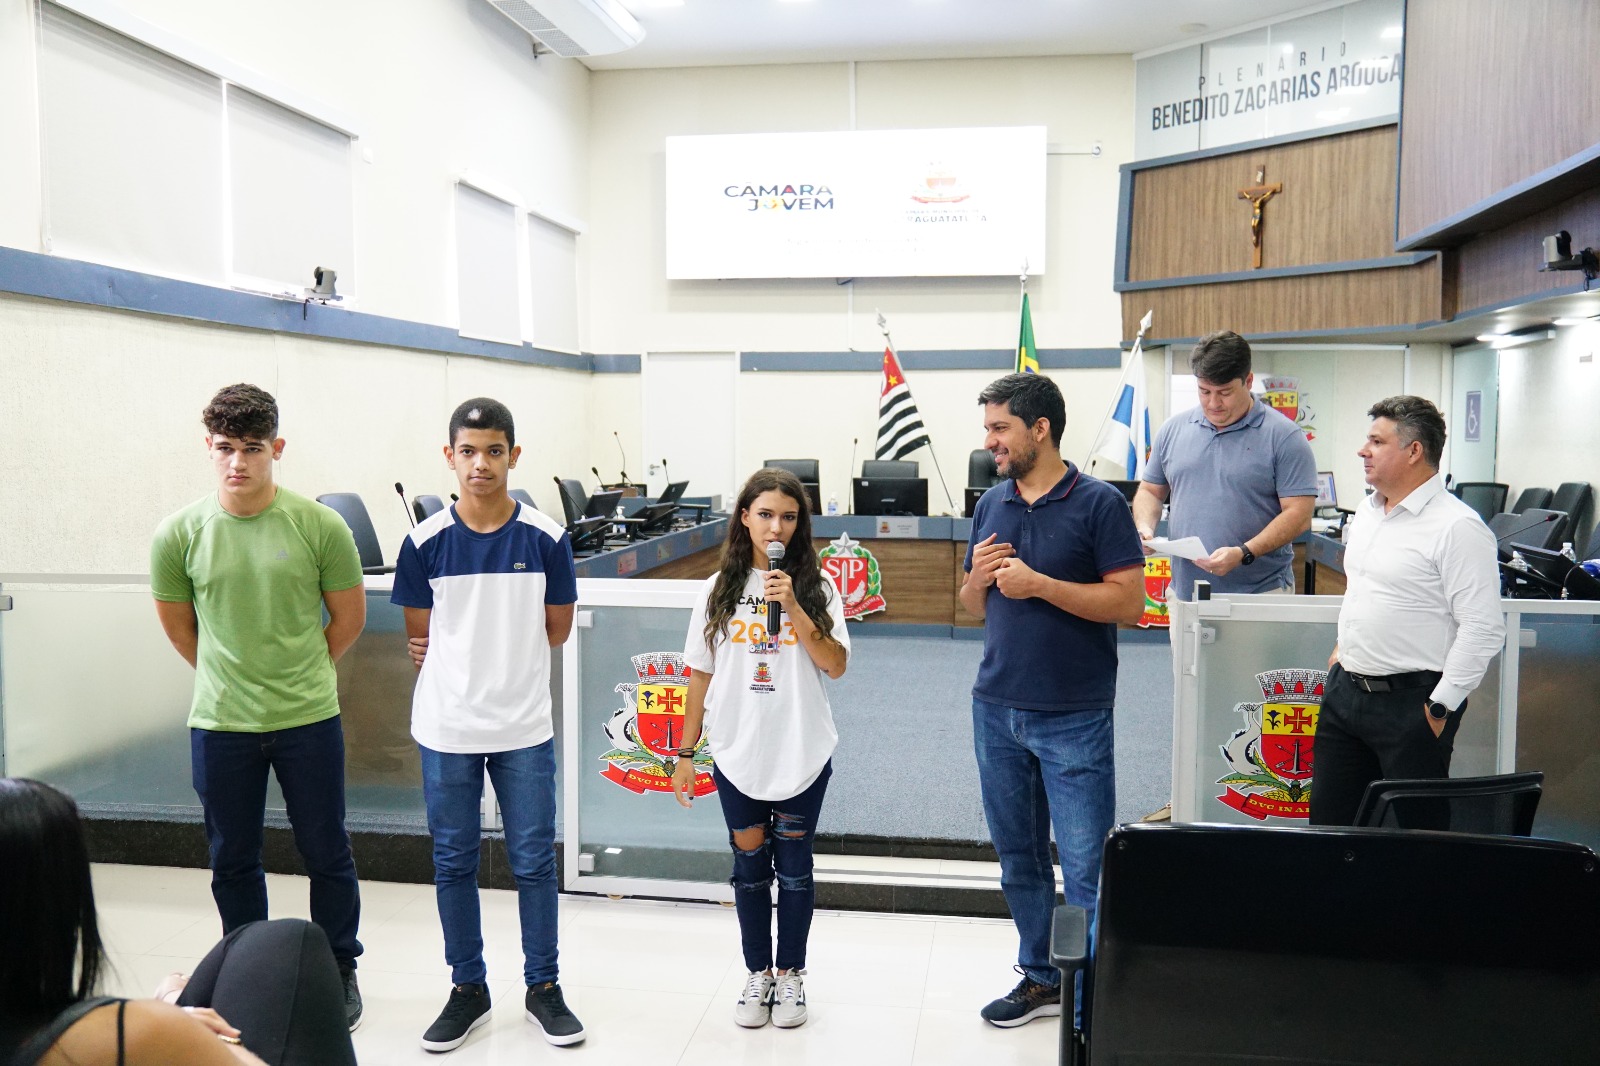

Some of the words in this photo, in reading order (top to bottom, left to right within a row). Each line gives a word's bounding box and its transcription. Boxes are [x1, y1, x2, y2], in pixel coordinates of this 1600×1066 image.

[1152, 92, 1229, 130] BENEDITO
[1233, 71, 1320, 115] ZACARIAS
[1326, 53, 1400, 95] AROUCA
[747, 197, 834, 212] JOVEM
[737, 594, 768, 606] CÂM
[730, 619, 799, 646] 203
[1248, 799, 1274, 809] DVC
